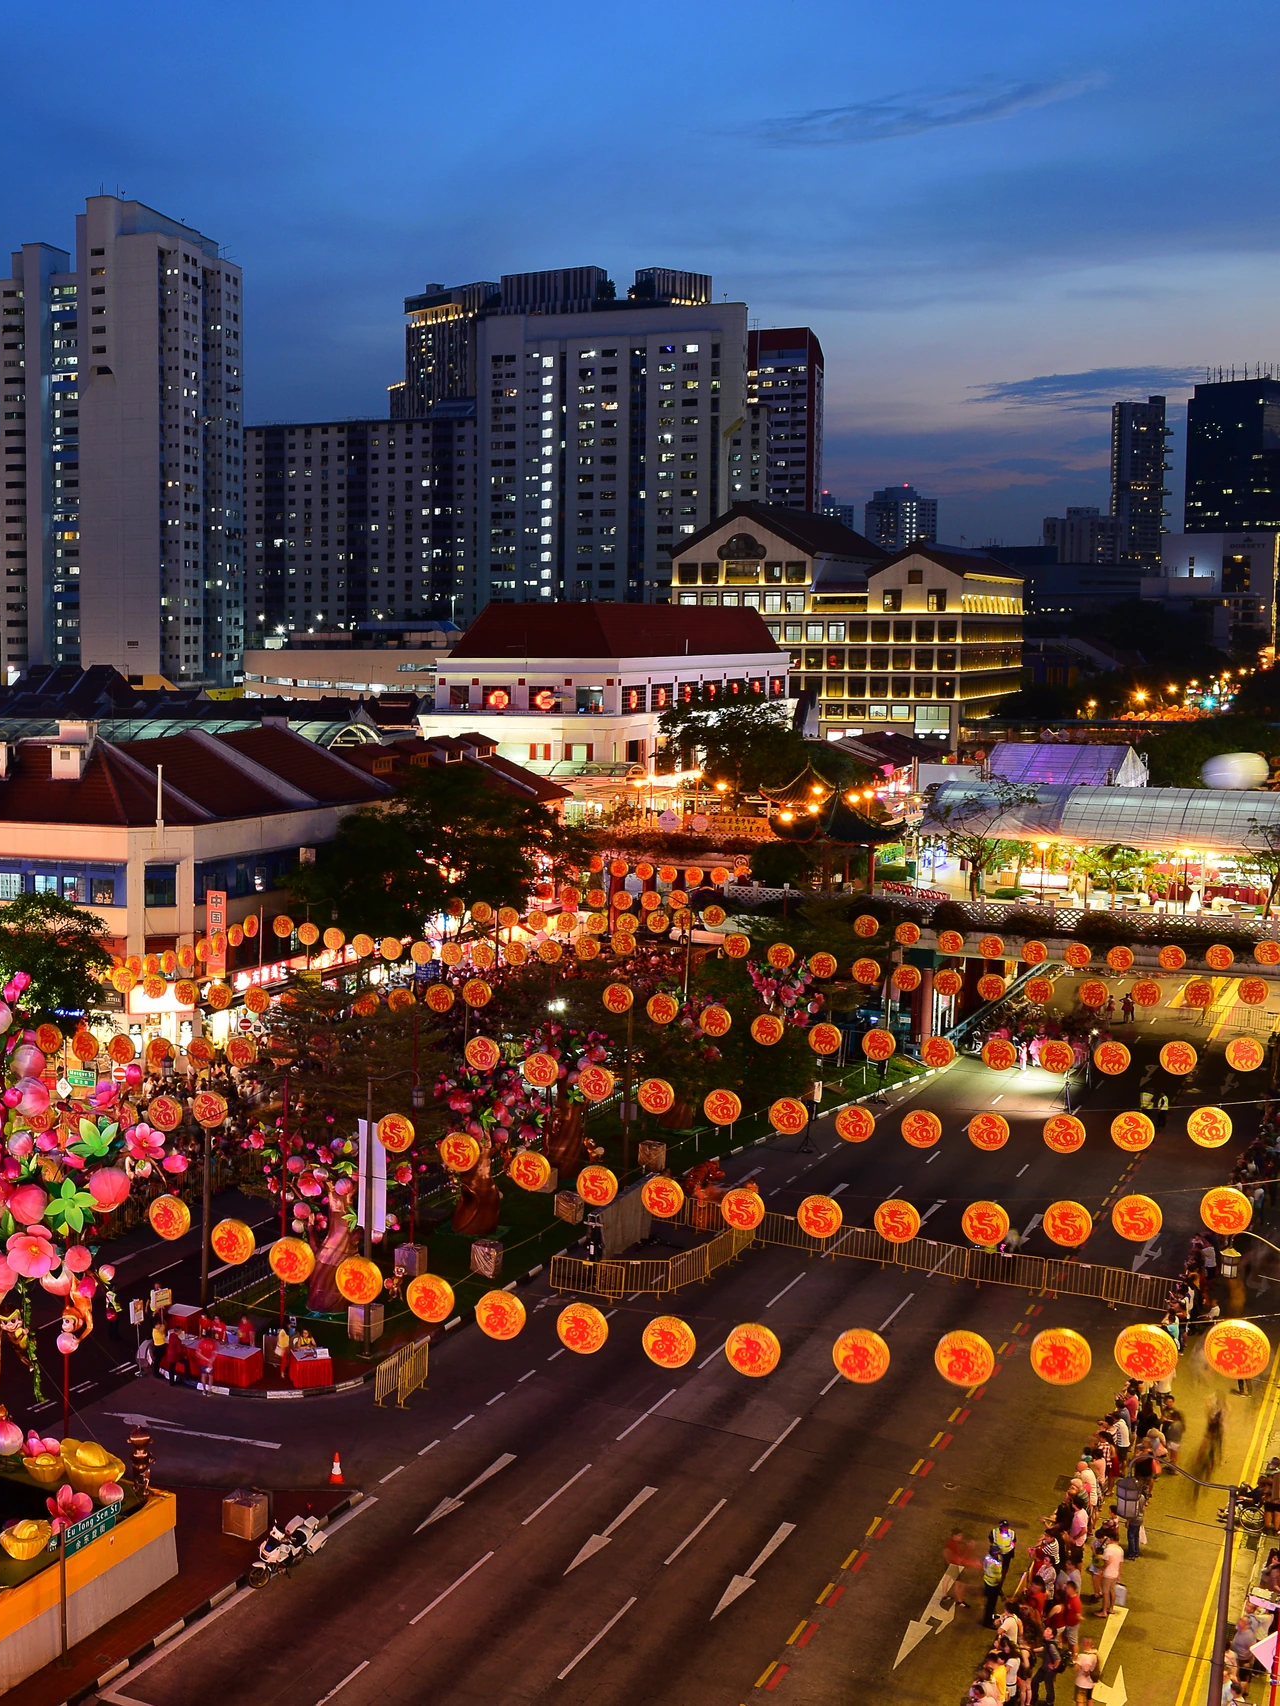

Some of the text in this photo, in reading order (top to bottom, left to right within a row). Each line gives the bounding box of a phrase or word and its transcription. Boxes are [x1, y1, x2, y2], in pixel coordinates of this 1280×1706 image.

[67, 1504, 118, 1538] Eu Tong Sen St
